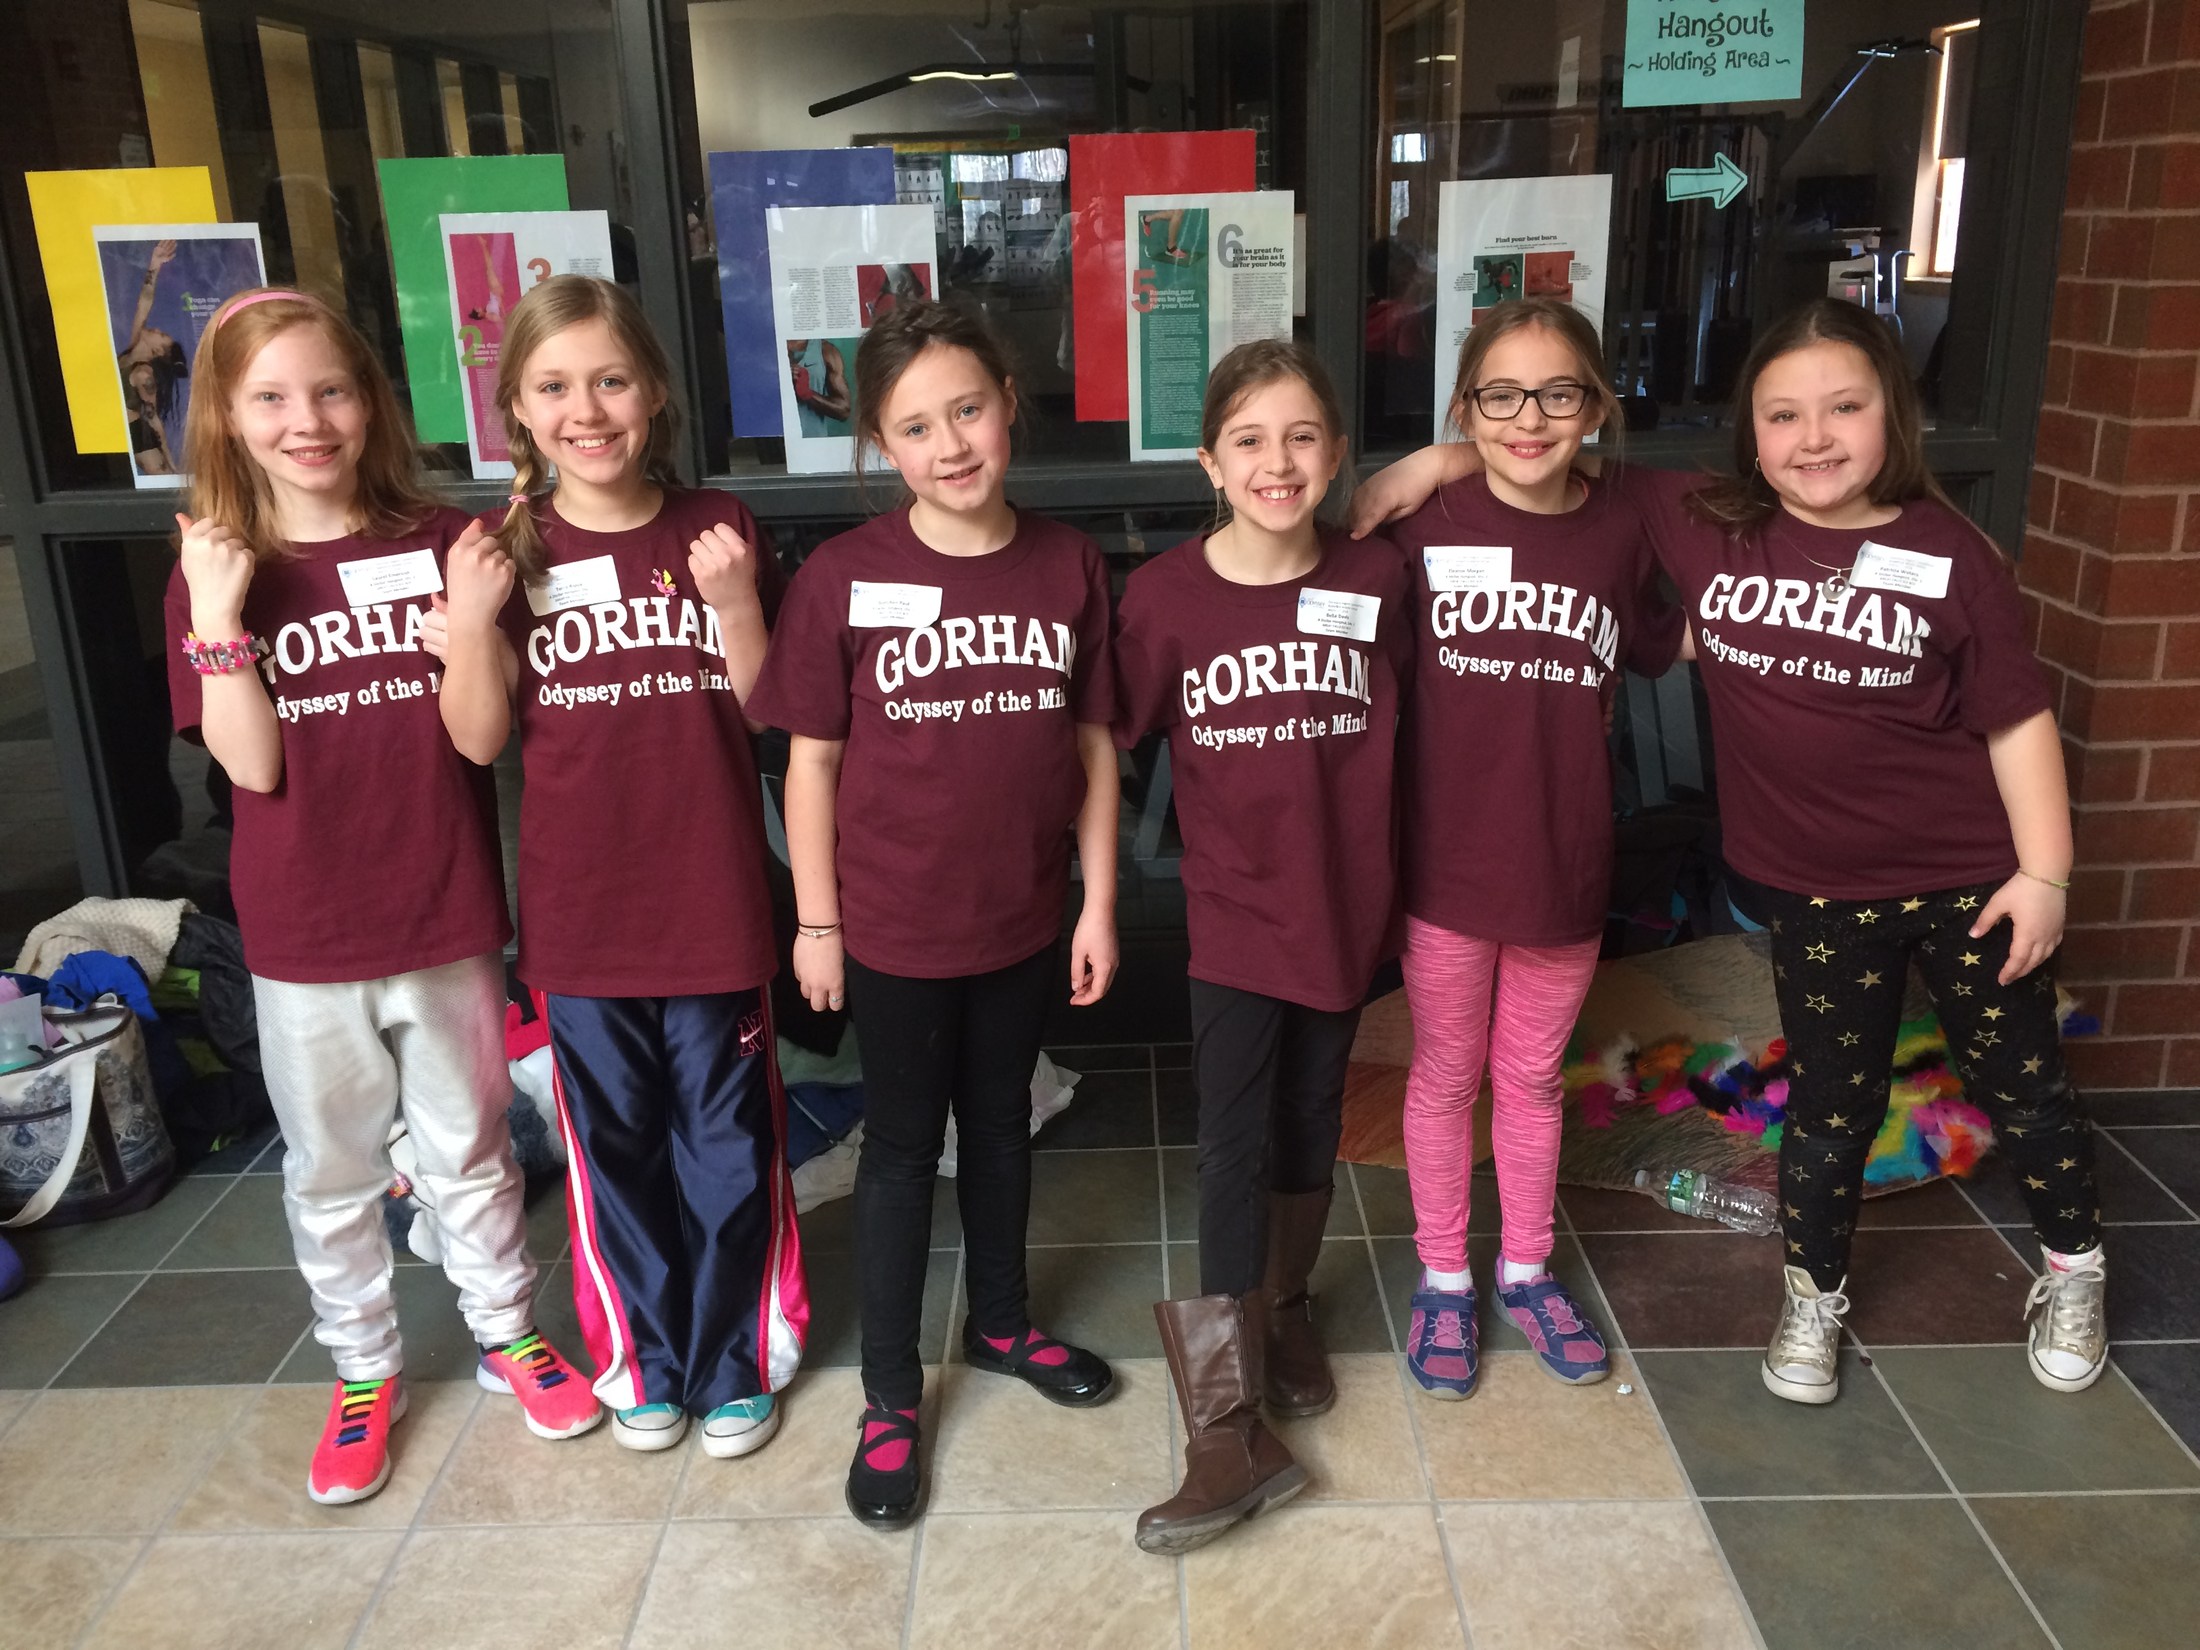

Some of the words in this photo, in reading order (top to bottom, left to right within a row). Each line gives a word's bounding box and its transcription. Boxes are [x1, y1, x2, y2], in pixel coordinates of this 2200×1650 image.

[1658, 8, 1774, 47] Hangout
[1648, 51, 1717, 77] Holding
[1725, 50, 1770, 69] Area
[1218, 224, 1244, 268] 6
[1251, 261, 1268, 269] your
[1253, 247, 1272, 255] great
[1131, 269, 1157, 313] 5
[458, 325, 485, 366] 2
[1431, 581, 1620, 672] GORHAM
[1699, 572, 1933, 659] GORHAM
[1438, 646, 1515, 682] Odyssey
[1520, 657, 1543, 680] of
[1544, 659, 1575, 684] the
[1702, 627, 1776, 676] Odyssey
[1782, 656, 1809, 677] of
[1812, 660, 1851, 685] the
[1858, 663, 1916, 688] Mind
[276, 691, 351, 723] dyssey
[357, 681, 381, 705] of
[385, 676, 424, 701] the
[538, 682, 622, 711] Odyssey
[629, 673, 652, 698] of
[657, 670, 693, 694] the
[1182, 641, 1372, 718] GORHAM
[884, 698, 965, 724] Odyssey
[971, 691, 994, 715] of
[998, 689, 1032, 712] the
[1191, 725, 1268, 752] Odyssey
[1274, 717, 1297, 742] of
[1301, 715, 1327, 739] the
[1331, 710, 1368, 736] Mind
